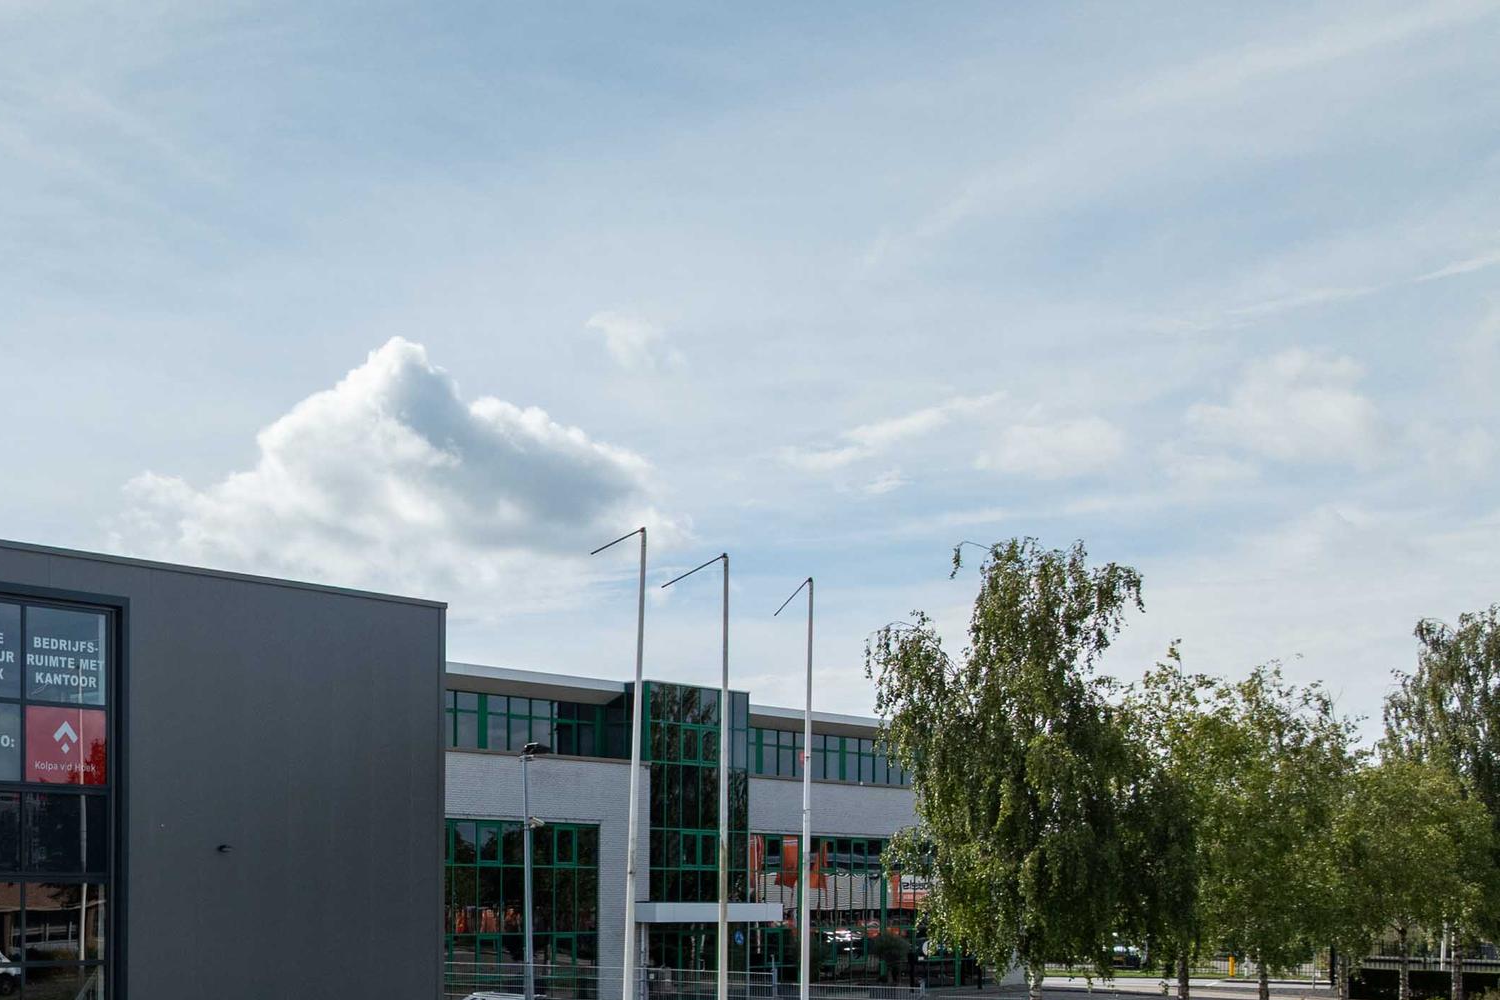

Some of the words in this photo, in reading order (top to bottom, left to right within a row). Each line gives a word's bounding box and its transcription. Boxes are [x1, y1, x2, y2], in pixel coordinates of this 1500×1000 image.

[26, 653, 76, 669] RUIMTE
[80, 659, 105, 671] MET
[35, 672, 97, 688] KANTOOR
[34, 760, 58, 772] Kolpa
